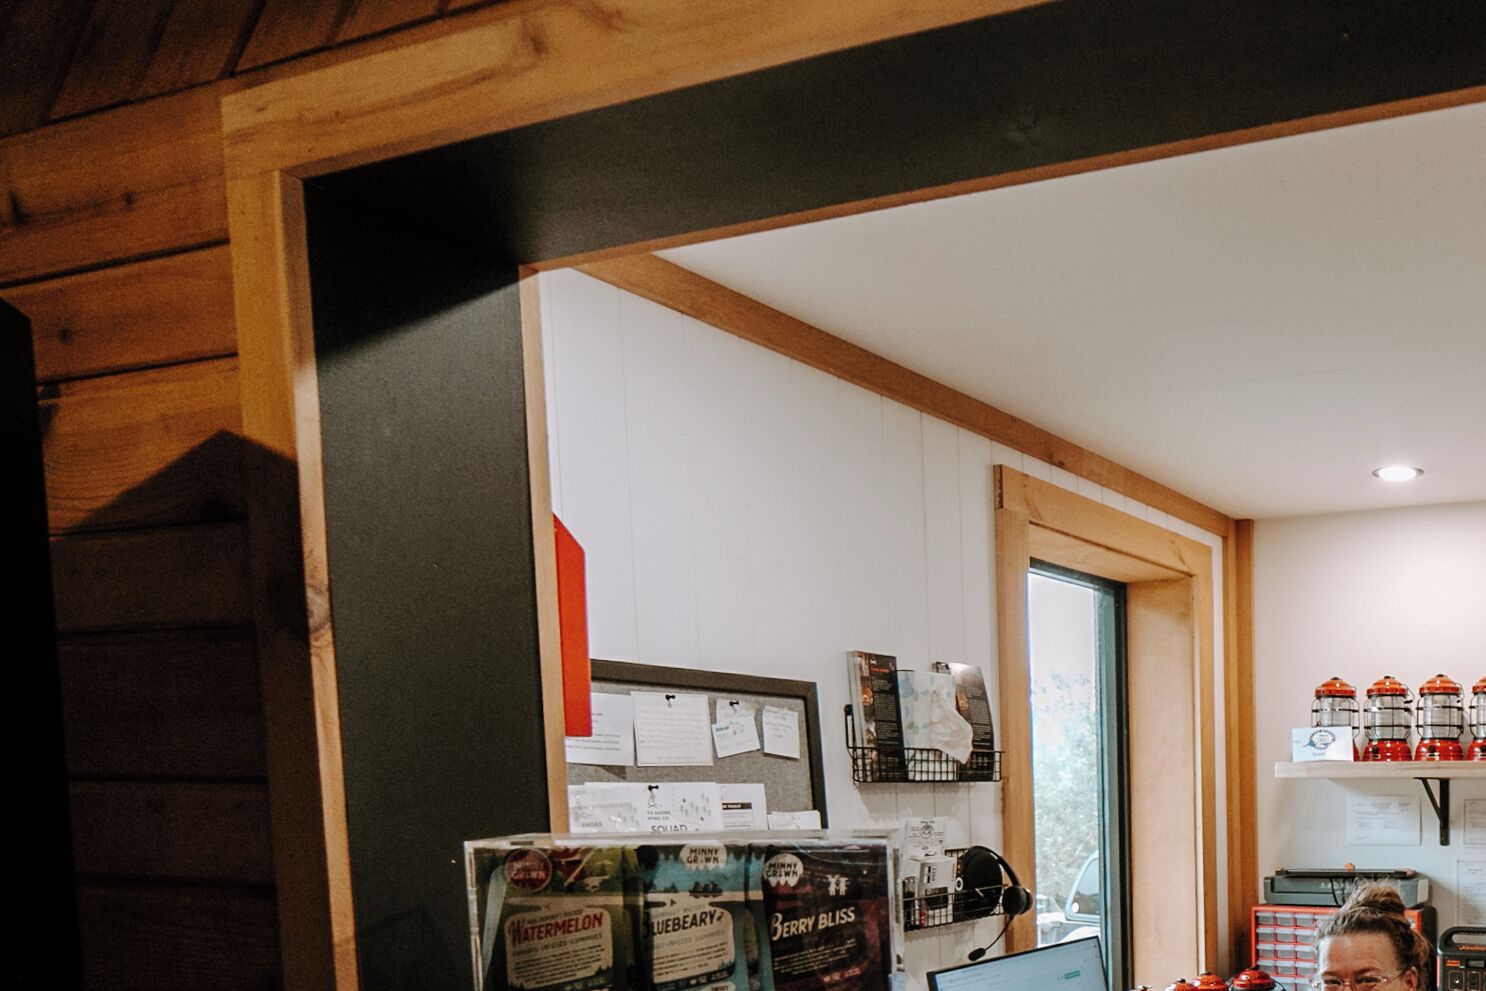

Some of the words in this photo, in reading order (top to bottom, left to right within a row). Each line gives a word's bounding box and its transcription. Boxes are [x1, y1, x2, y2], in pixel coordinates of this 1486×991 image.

[769, 862, 798, 870] MINNY
[508, 912, 603, 946] WATERMELON
[772, 912, 815, 941] BERRY
[818, 907, 855, 930] BLISS
